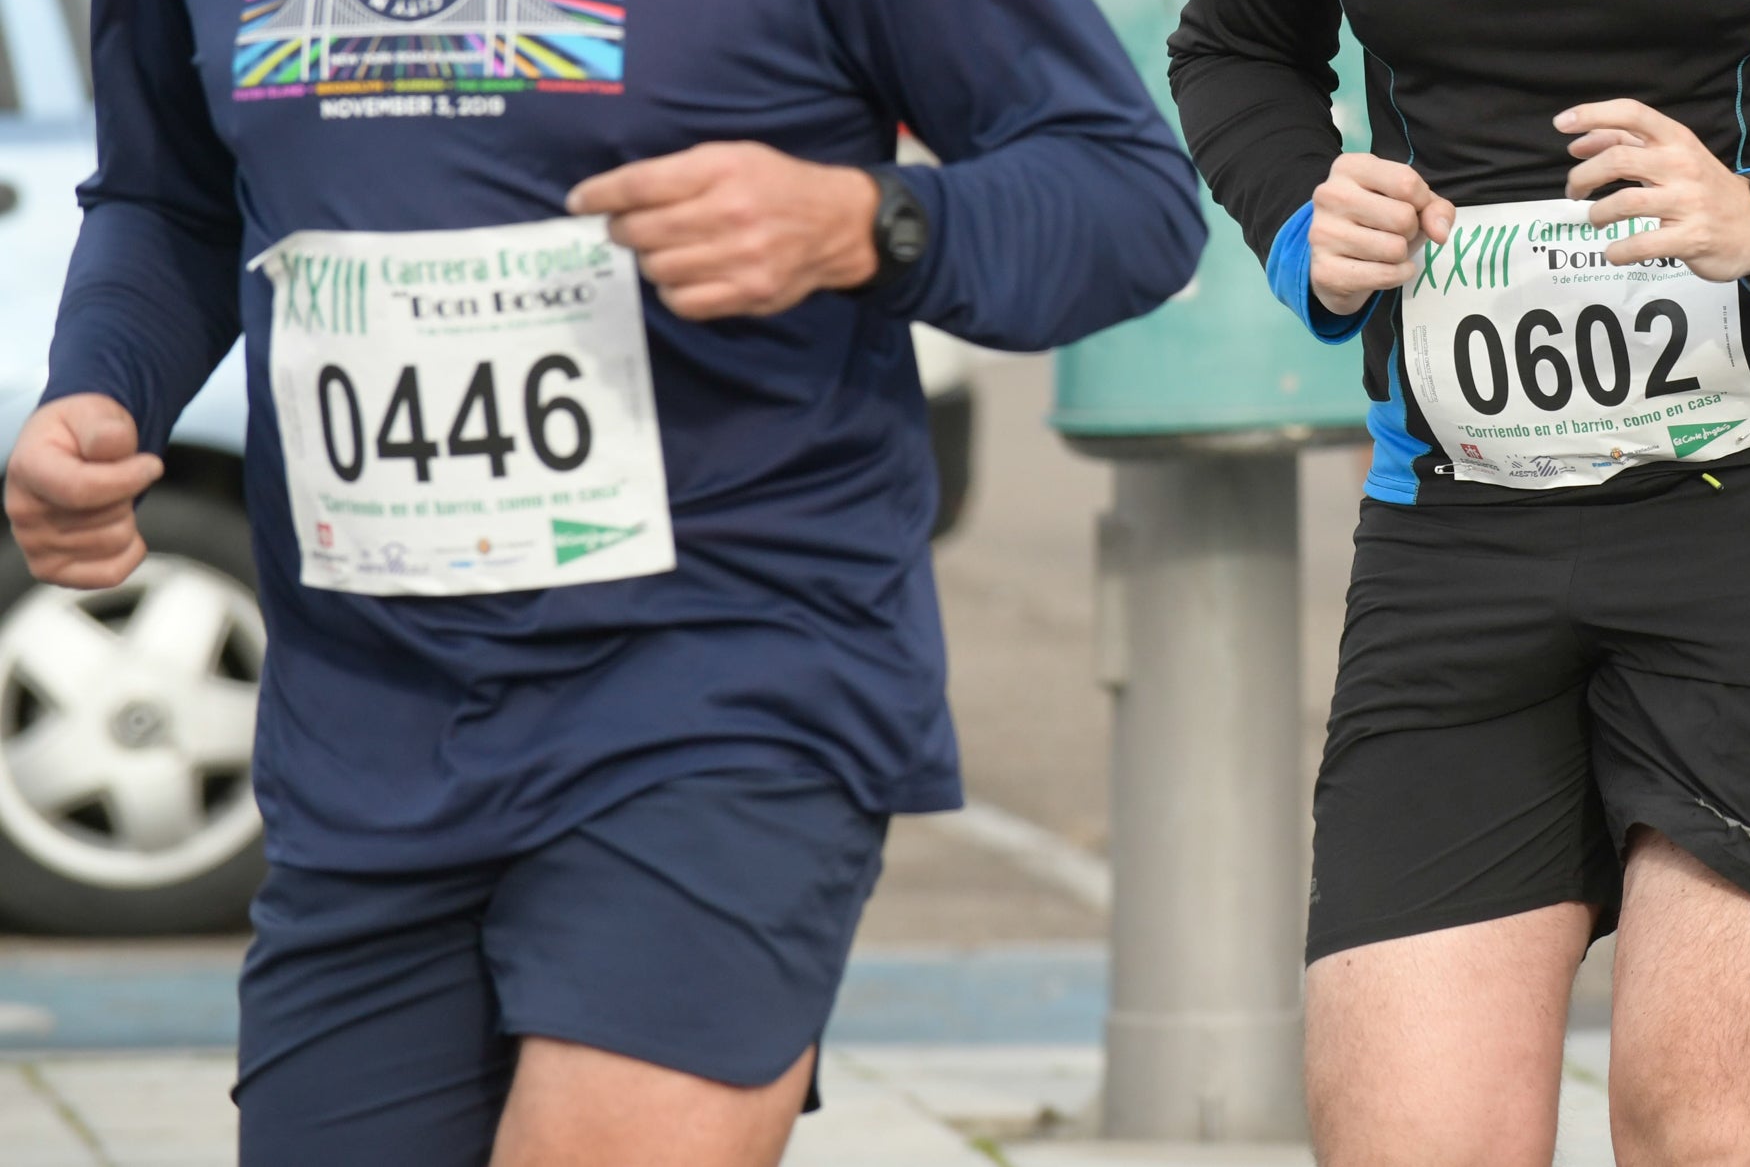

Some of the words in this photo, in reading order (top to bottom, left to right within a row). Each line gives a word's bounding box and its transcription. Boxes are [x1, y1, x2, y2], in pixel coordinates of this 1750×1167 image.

[319, 95, 434, 120] NOVEMBER
[435, 94, 456, 120] 3,
[381, 254, 489, 285] Carrera
[1412, 224, 1520, 299] XXIII
[1552, 275, 1558, 284] 9
[1560, 273, 1571, 284] de
[1573, 272, 1611, 283] febrero
[1613, 272, 1625, 281] de
[1627, 271, 1651, 282] 2020,
[280, 251, 368, 335] XXIII
[1453, 298, 1701, 416] 0602
[318, 353, 593, 483] 0446
[1534, 425, 1551, 436] en
[1555, 420, 1568, 435] el
[1571, 417, 1619, 434] barrio,
[1623, 411, 1662, 428] como
[1665, 404, 1684, 417] en
